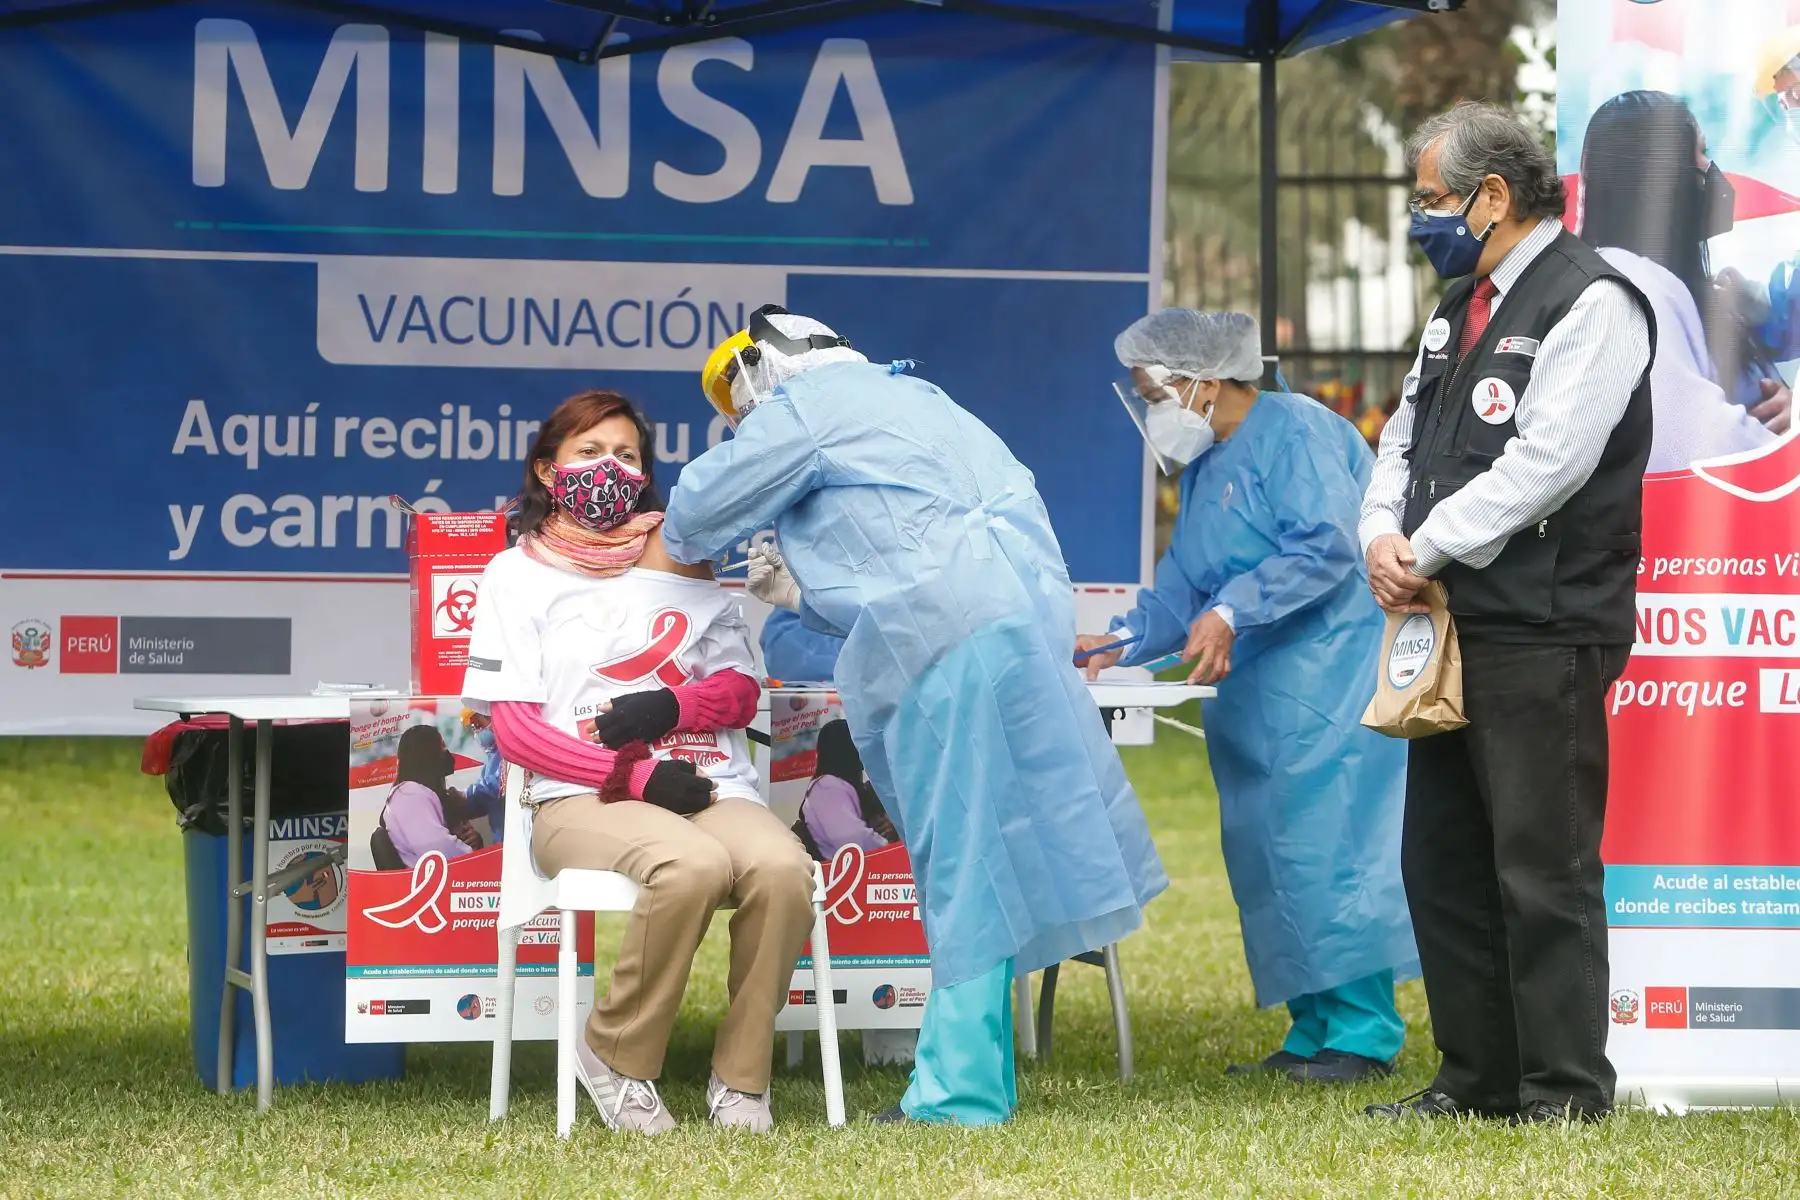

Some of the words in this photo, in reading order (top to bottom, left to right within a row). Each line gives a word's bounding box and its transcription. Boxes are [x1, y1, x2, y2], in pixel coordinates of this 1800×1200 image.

[193, 18, 914, 205] MINSA
[358, 287, 744, 350] VACUNACIÓN
[172, 400, 320, 470] Aquí
[334, 402, 541, 461] recibir
[648, 417, 690, 464] u
[168, 504, 205, 561] y
[1653, 556, 1767, 581] personas
[1636, 607, 1707, 646] NOS
[1721, 605, 1796, 646] VAC
[68, 633, 111, 652] PERÚ
[129, 637, 194, 650] Ministerio
[1392, 638, 1430, 658] MINSA
[129, 652, 144, 664] de
[148, 652, 183, 664] Salud
[1611, 679, 1748, 717] porque
[574, 703, 592, 716] Las
[381, 713, 410, 726] hombro
[660, 733, 678, 747] La
[269, 816, 348, 840] MINSA
[301, 843, 313, 853] por
[882, 872, 913, 881] persona
[1653, 874, 1708, 890] Acude
[1713, 874, 1728, 890] al
[452, 880, 464, 888] Las
[874, 888, 898, 900] NOS
[458, 896, 483, 908] NOS
[1614, 898, 1670, 914] donde
[1675, 898, 1736, 914] recibes
[868, 909, 910, 922] porque
[452, 918, 494, 930] porque
[522, 935, 534, 944] es
[1650, 999, 1683, 1014] PERÚ
[1695, 1002, 1743, 1012] Ministerio
[1695, 1013, 1708, 1022] de
[1710, 1013, 1735, 1022] Salud
